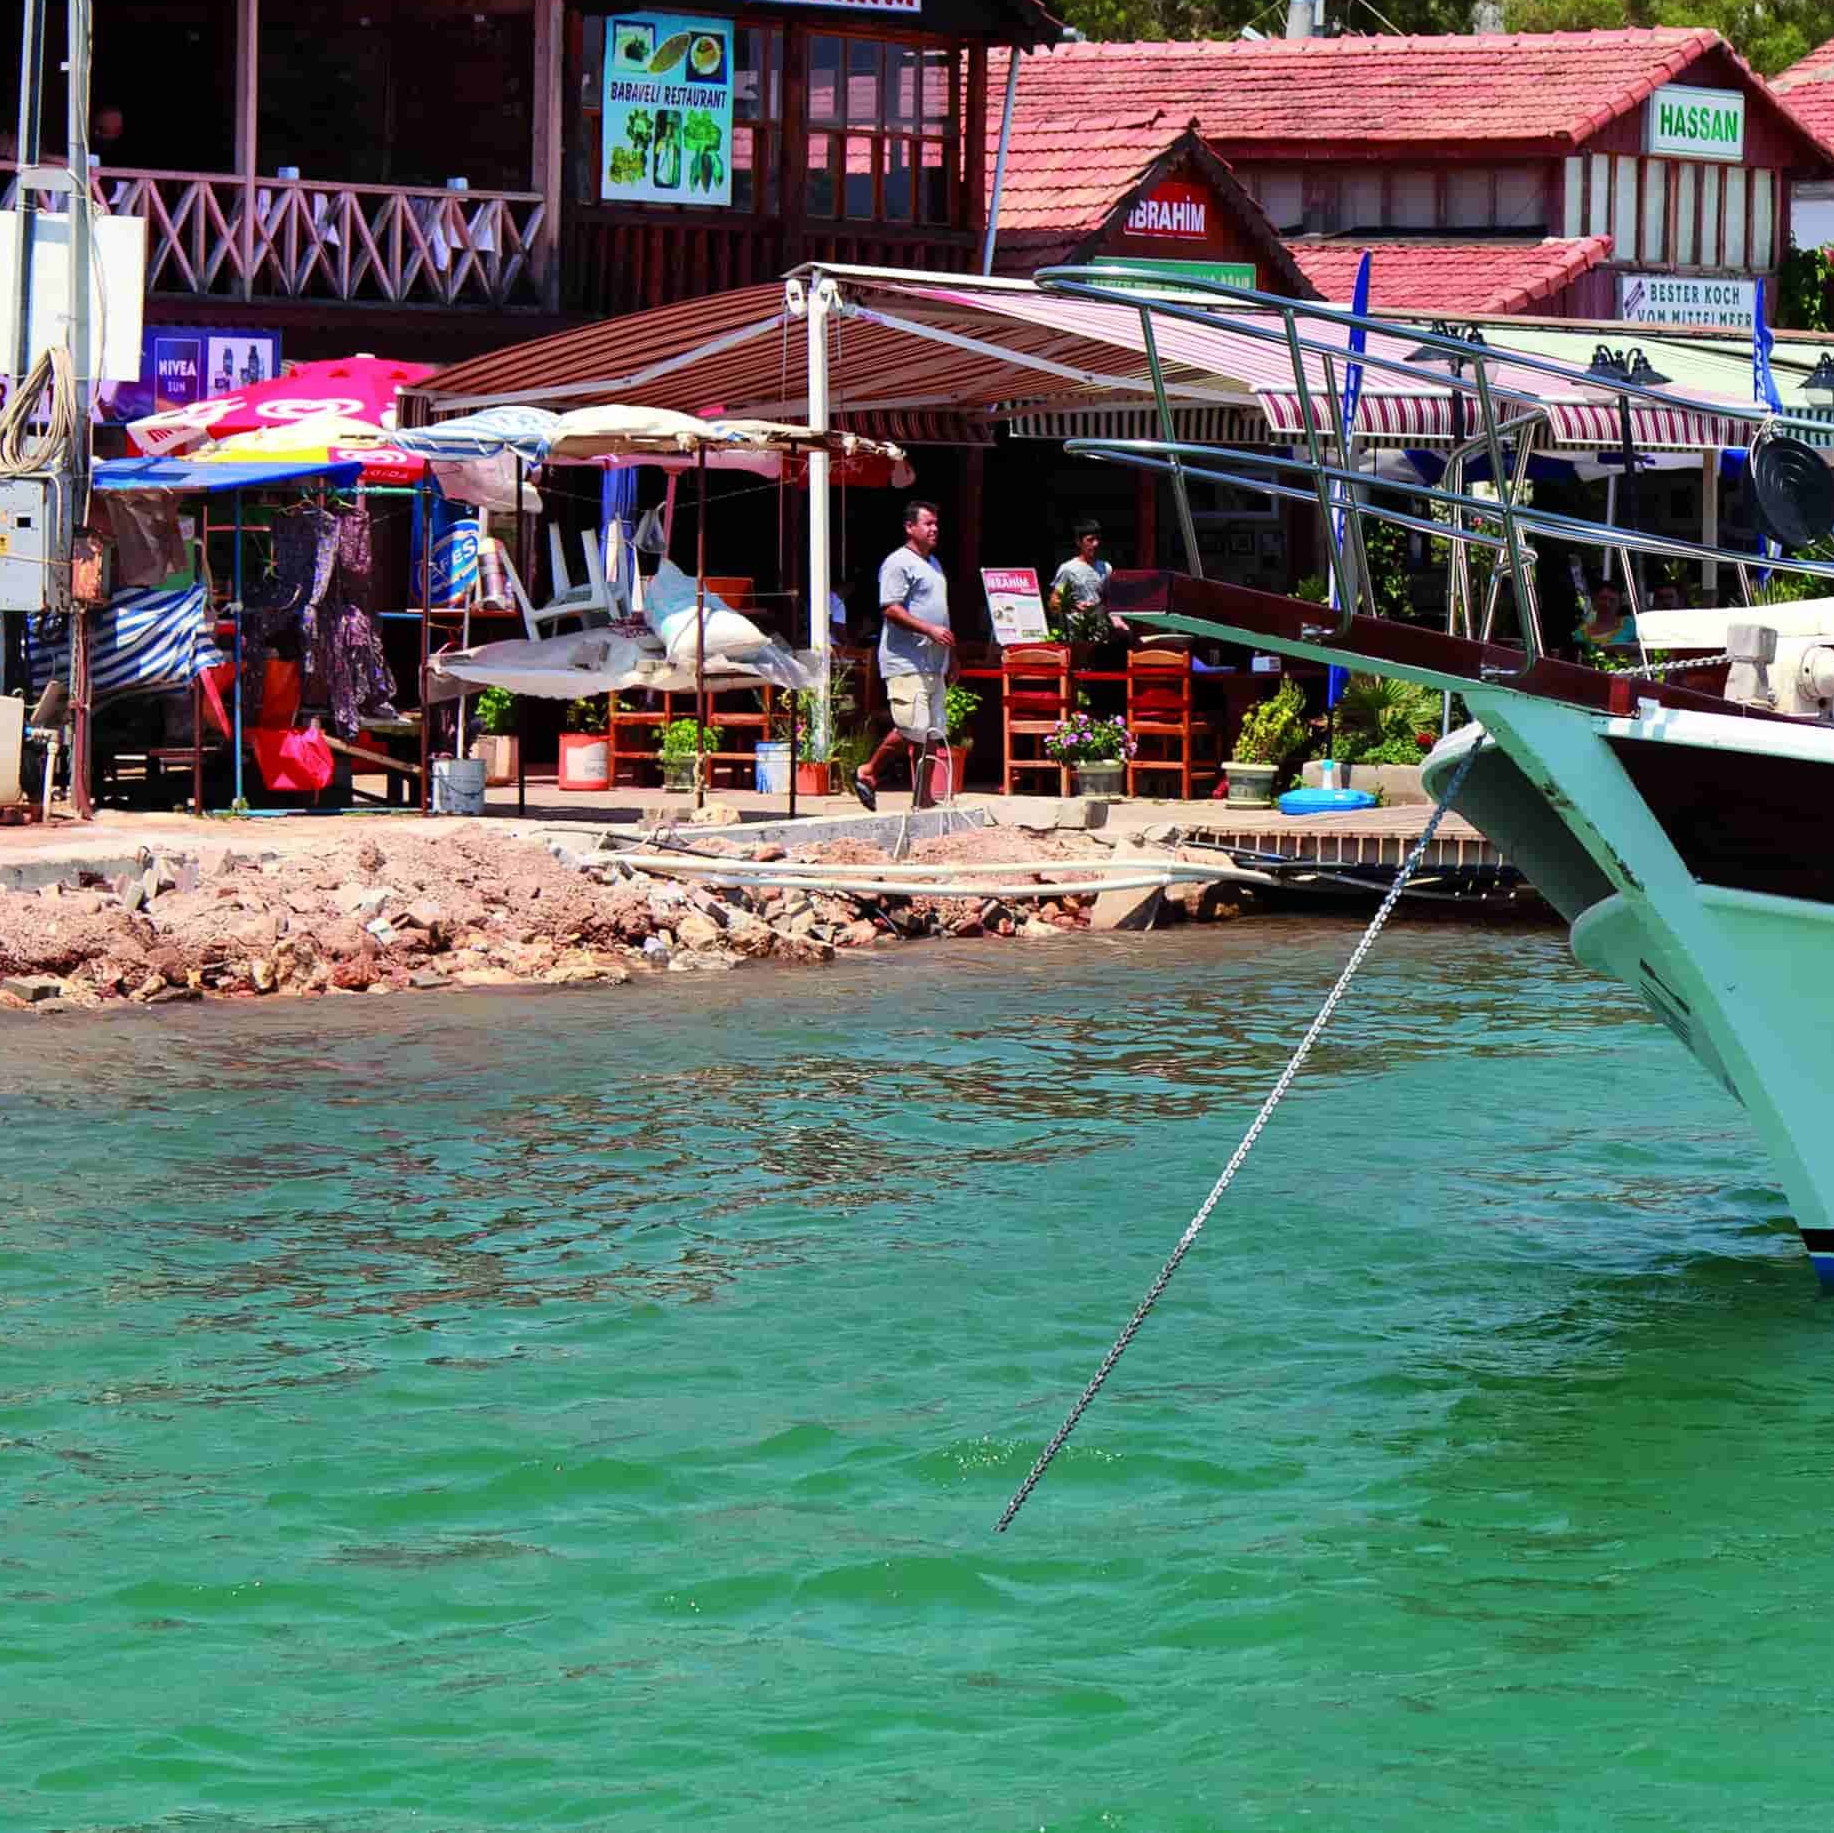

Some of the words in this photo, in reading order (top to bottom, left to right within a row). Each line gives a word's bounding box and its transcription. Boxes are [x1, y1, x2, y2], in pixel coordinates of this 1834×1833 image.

[664, 85, 727, 109] RESTAURANT
[1660, 102, 1738, 143] HASSAN
[1650, 283, 1700, 303] BESTER
[1704, 286, 1740, 306] KOCH
[1637, 309, 1666, 323] VOM
[159, 360, 197, 376] NIVEA
